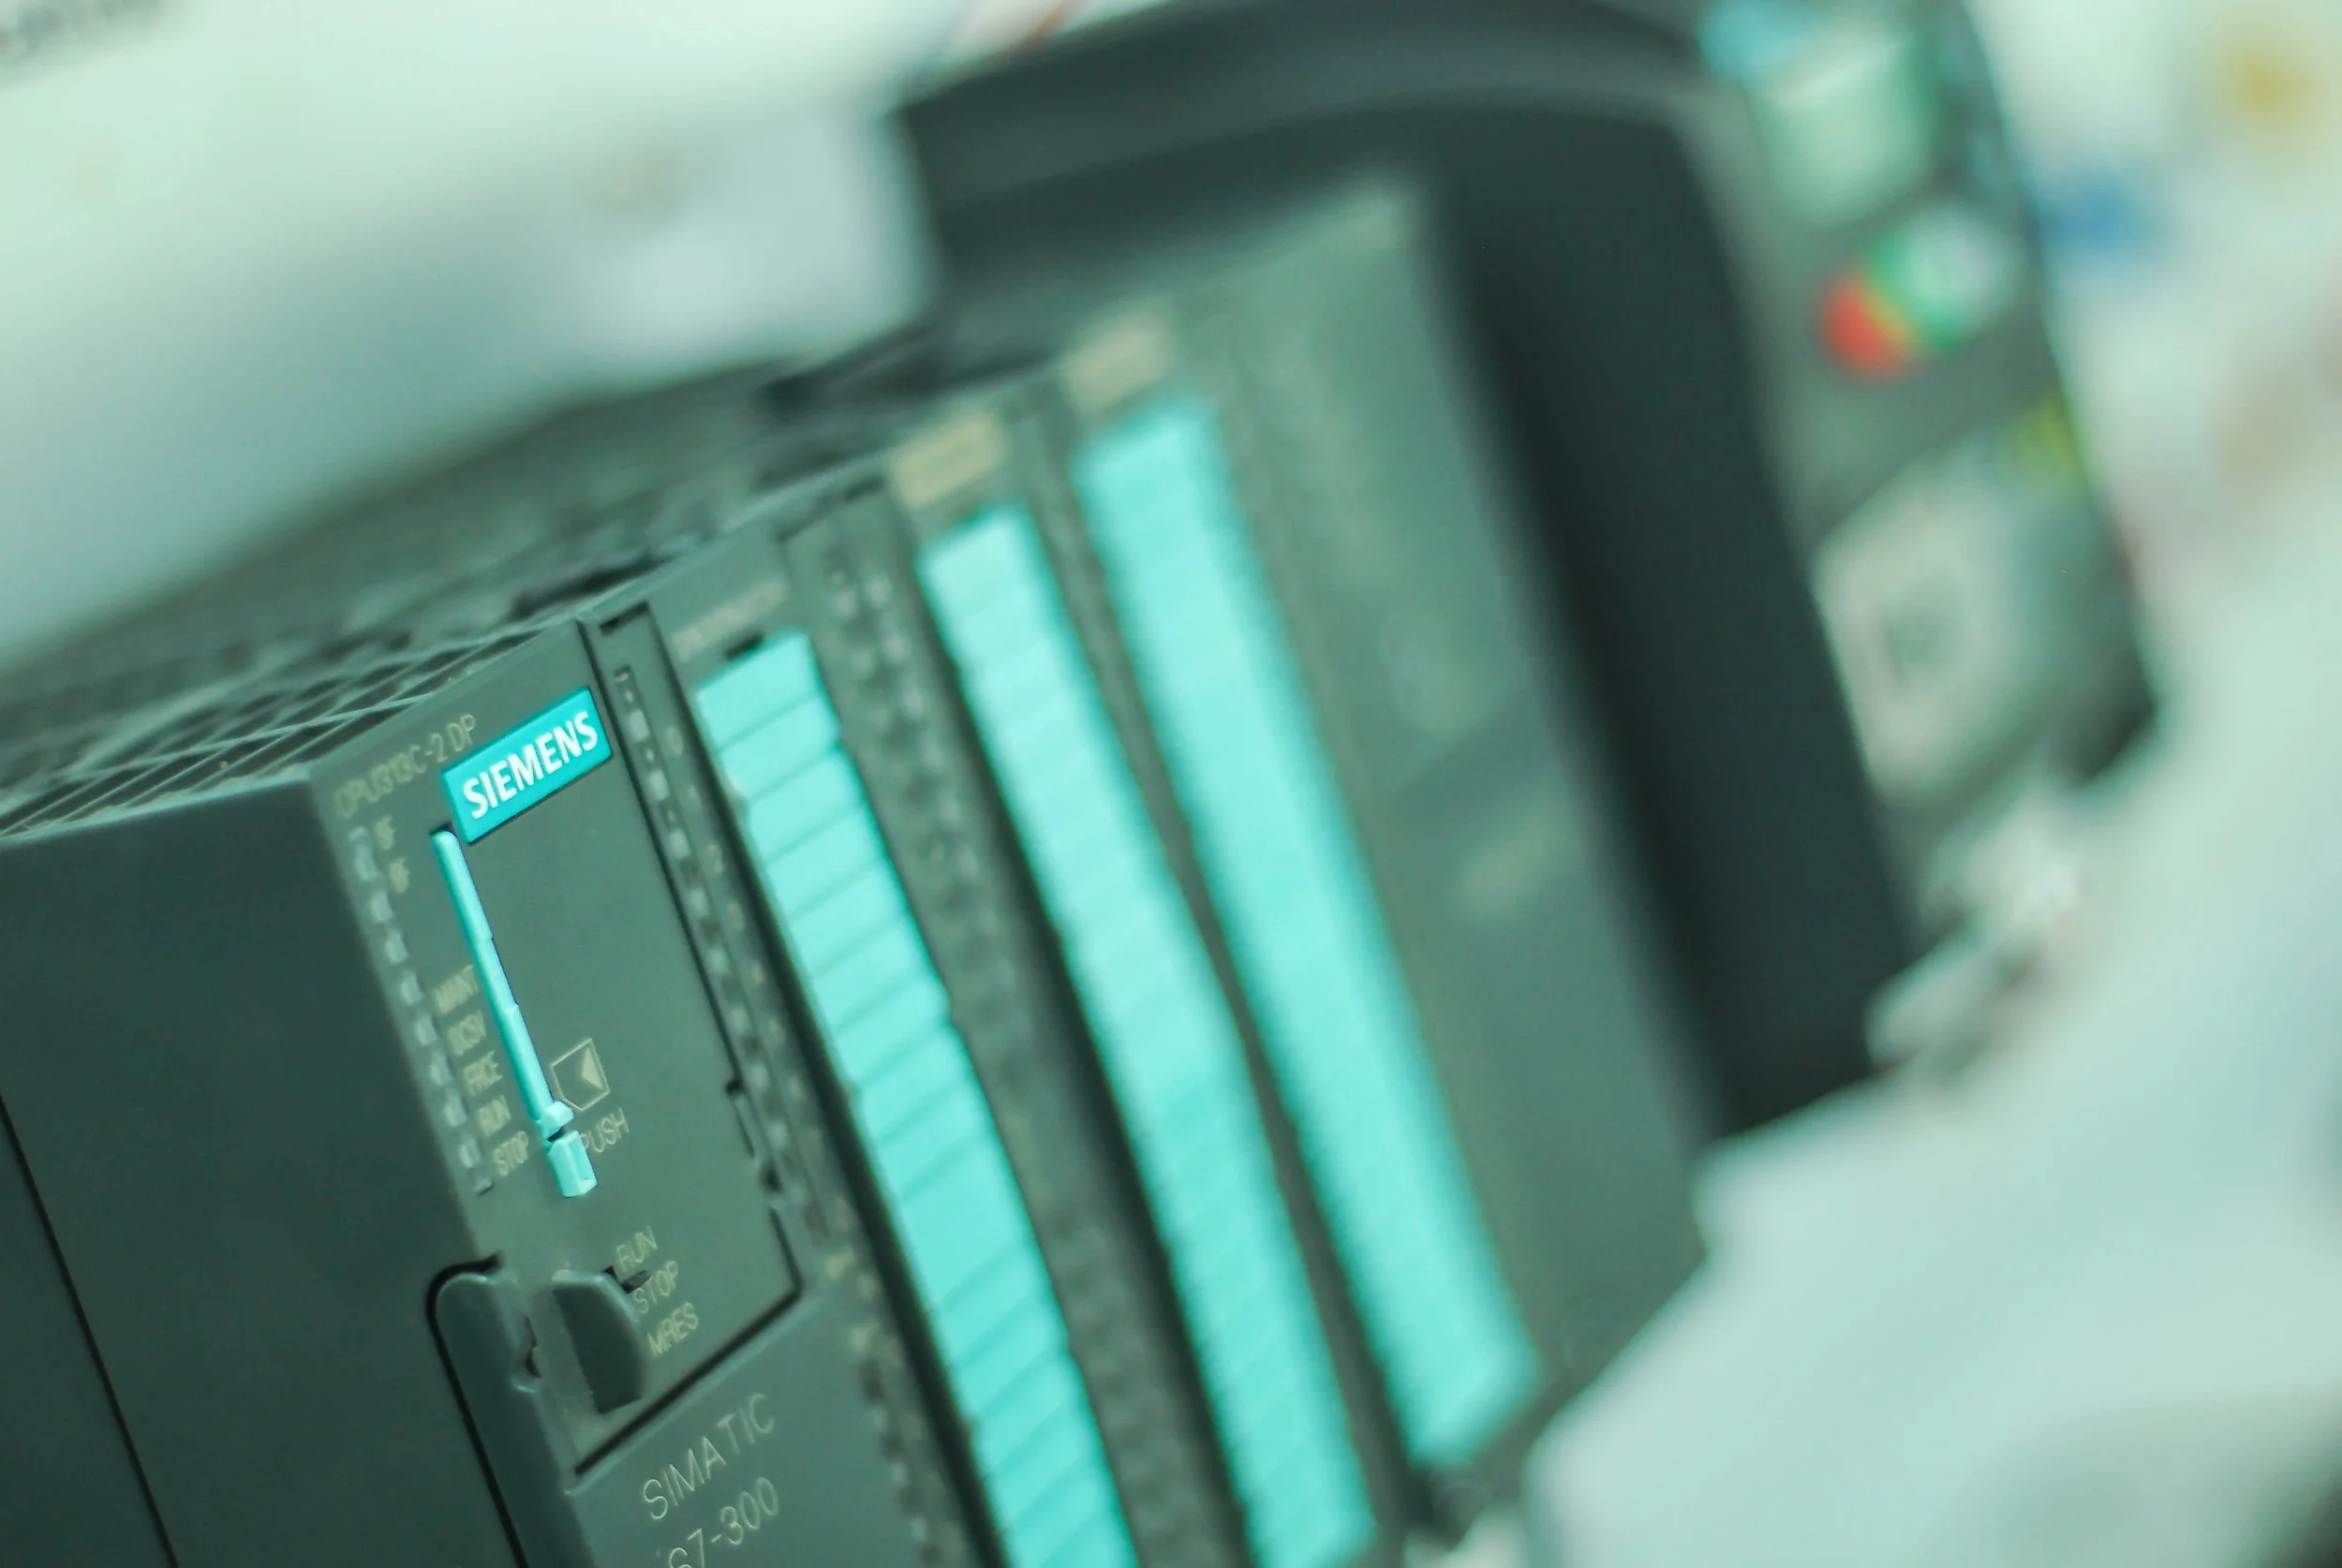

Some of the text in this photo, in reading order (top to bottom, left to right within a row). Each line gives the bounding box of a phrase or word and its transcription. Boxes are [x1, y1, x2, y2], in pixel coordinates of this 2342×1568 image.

[446, 713, 476, 753] DP
[462, 710, 599, 821] SIEMENS
[615, 1224, 659, 1273] RUN
[631, 1259, 681, 1315] STOP
[646, 1301, 701, 1357] MRES
[642, 1392, 776, 1521] SIMATIC
